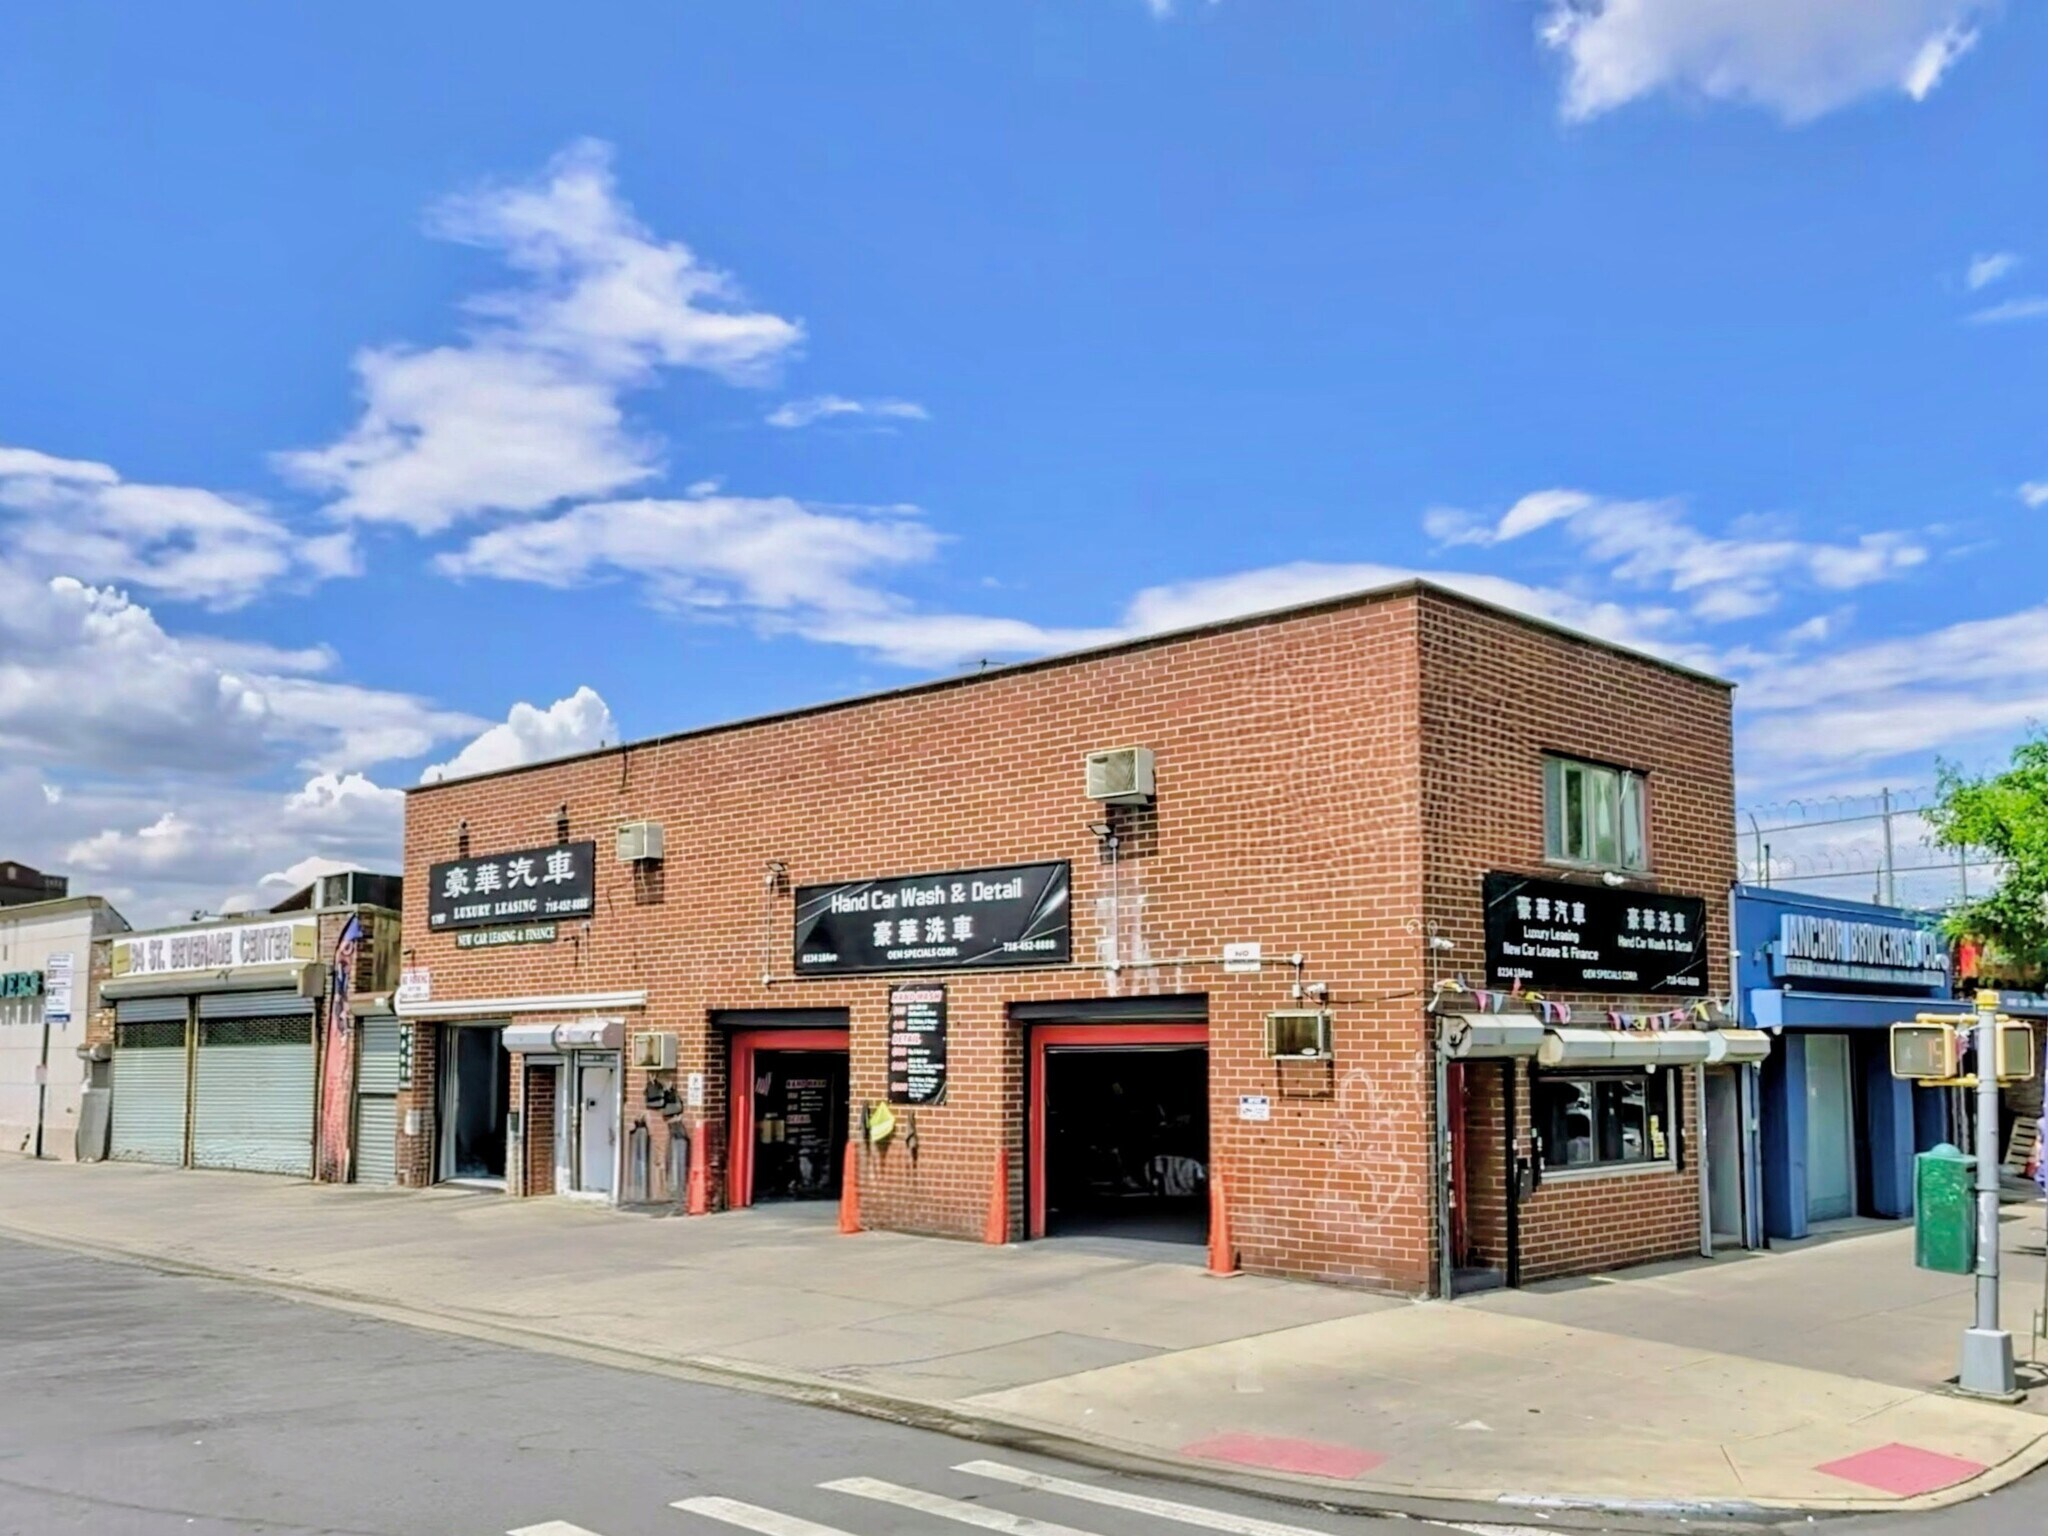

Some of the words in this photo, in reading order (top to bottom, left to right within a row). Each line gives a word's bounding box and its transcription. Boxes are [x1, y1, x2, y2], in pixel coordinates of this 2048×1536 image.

[442, 850, 575, 898] 豪華汽車
[831, 891, 868, 913] Hand
[871, 890, 897, 910] Car
[901, 885, 945, 908] Wash
[951, 883, 966, 903] &
[971, 877, 1022, 902] Detail
[453, 903, 491, 919] LUXURY
[495, 899, 537, 915] LEASING
[458, 933, 473, 946] NEW
[473, 932, 488, 945] CAR
[488, 930, 516, 943] LEASING
[525, 927, 555, 940] FINANCE
[873, 914, 973, 947] 豪華洗車
[1523, 925, 1550, 941] Luxury
[1550, 927, 1580, 944] Leasing
[170, 932, 233, 969] BEVERAGE
[240, 926, 293, 964] CENTER
[1503, 941, 1521, 955] New
[1522, 943, 1535, 956] Car
[1536, 944, 1560, 958] Lease
[1561, 946, 1569, 958] &
[1570, 946, 1599, 960] Finance
[1617, 934, 1635, 949] Hand
[1635, 936, 1646, 949] Car
[1786, 915, 1843, 961] ANCHOR
[1850, 922, 1919, 968] BROKERAGE
[887, 949, 903, 960] OEM
[903, 948, 936, 959] SPECIALS
